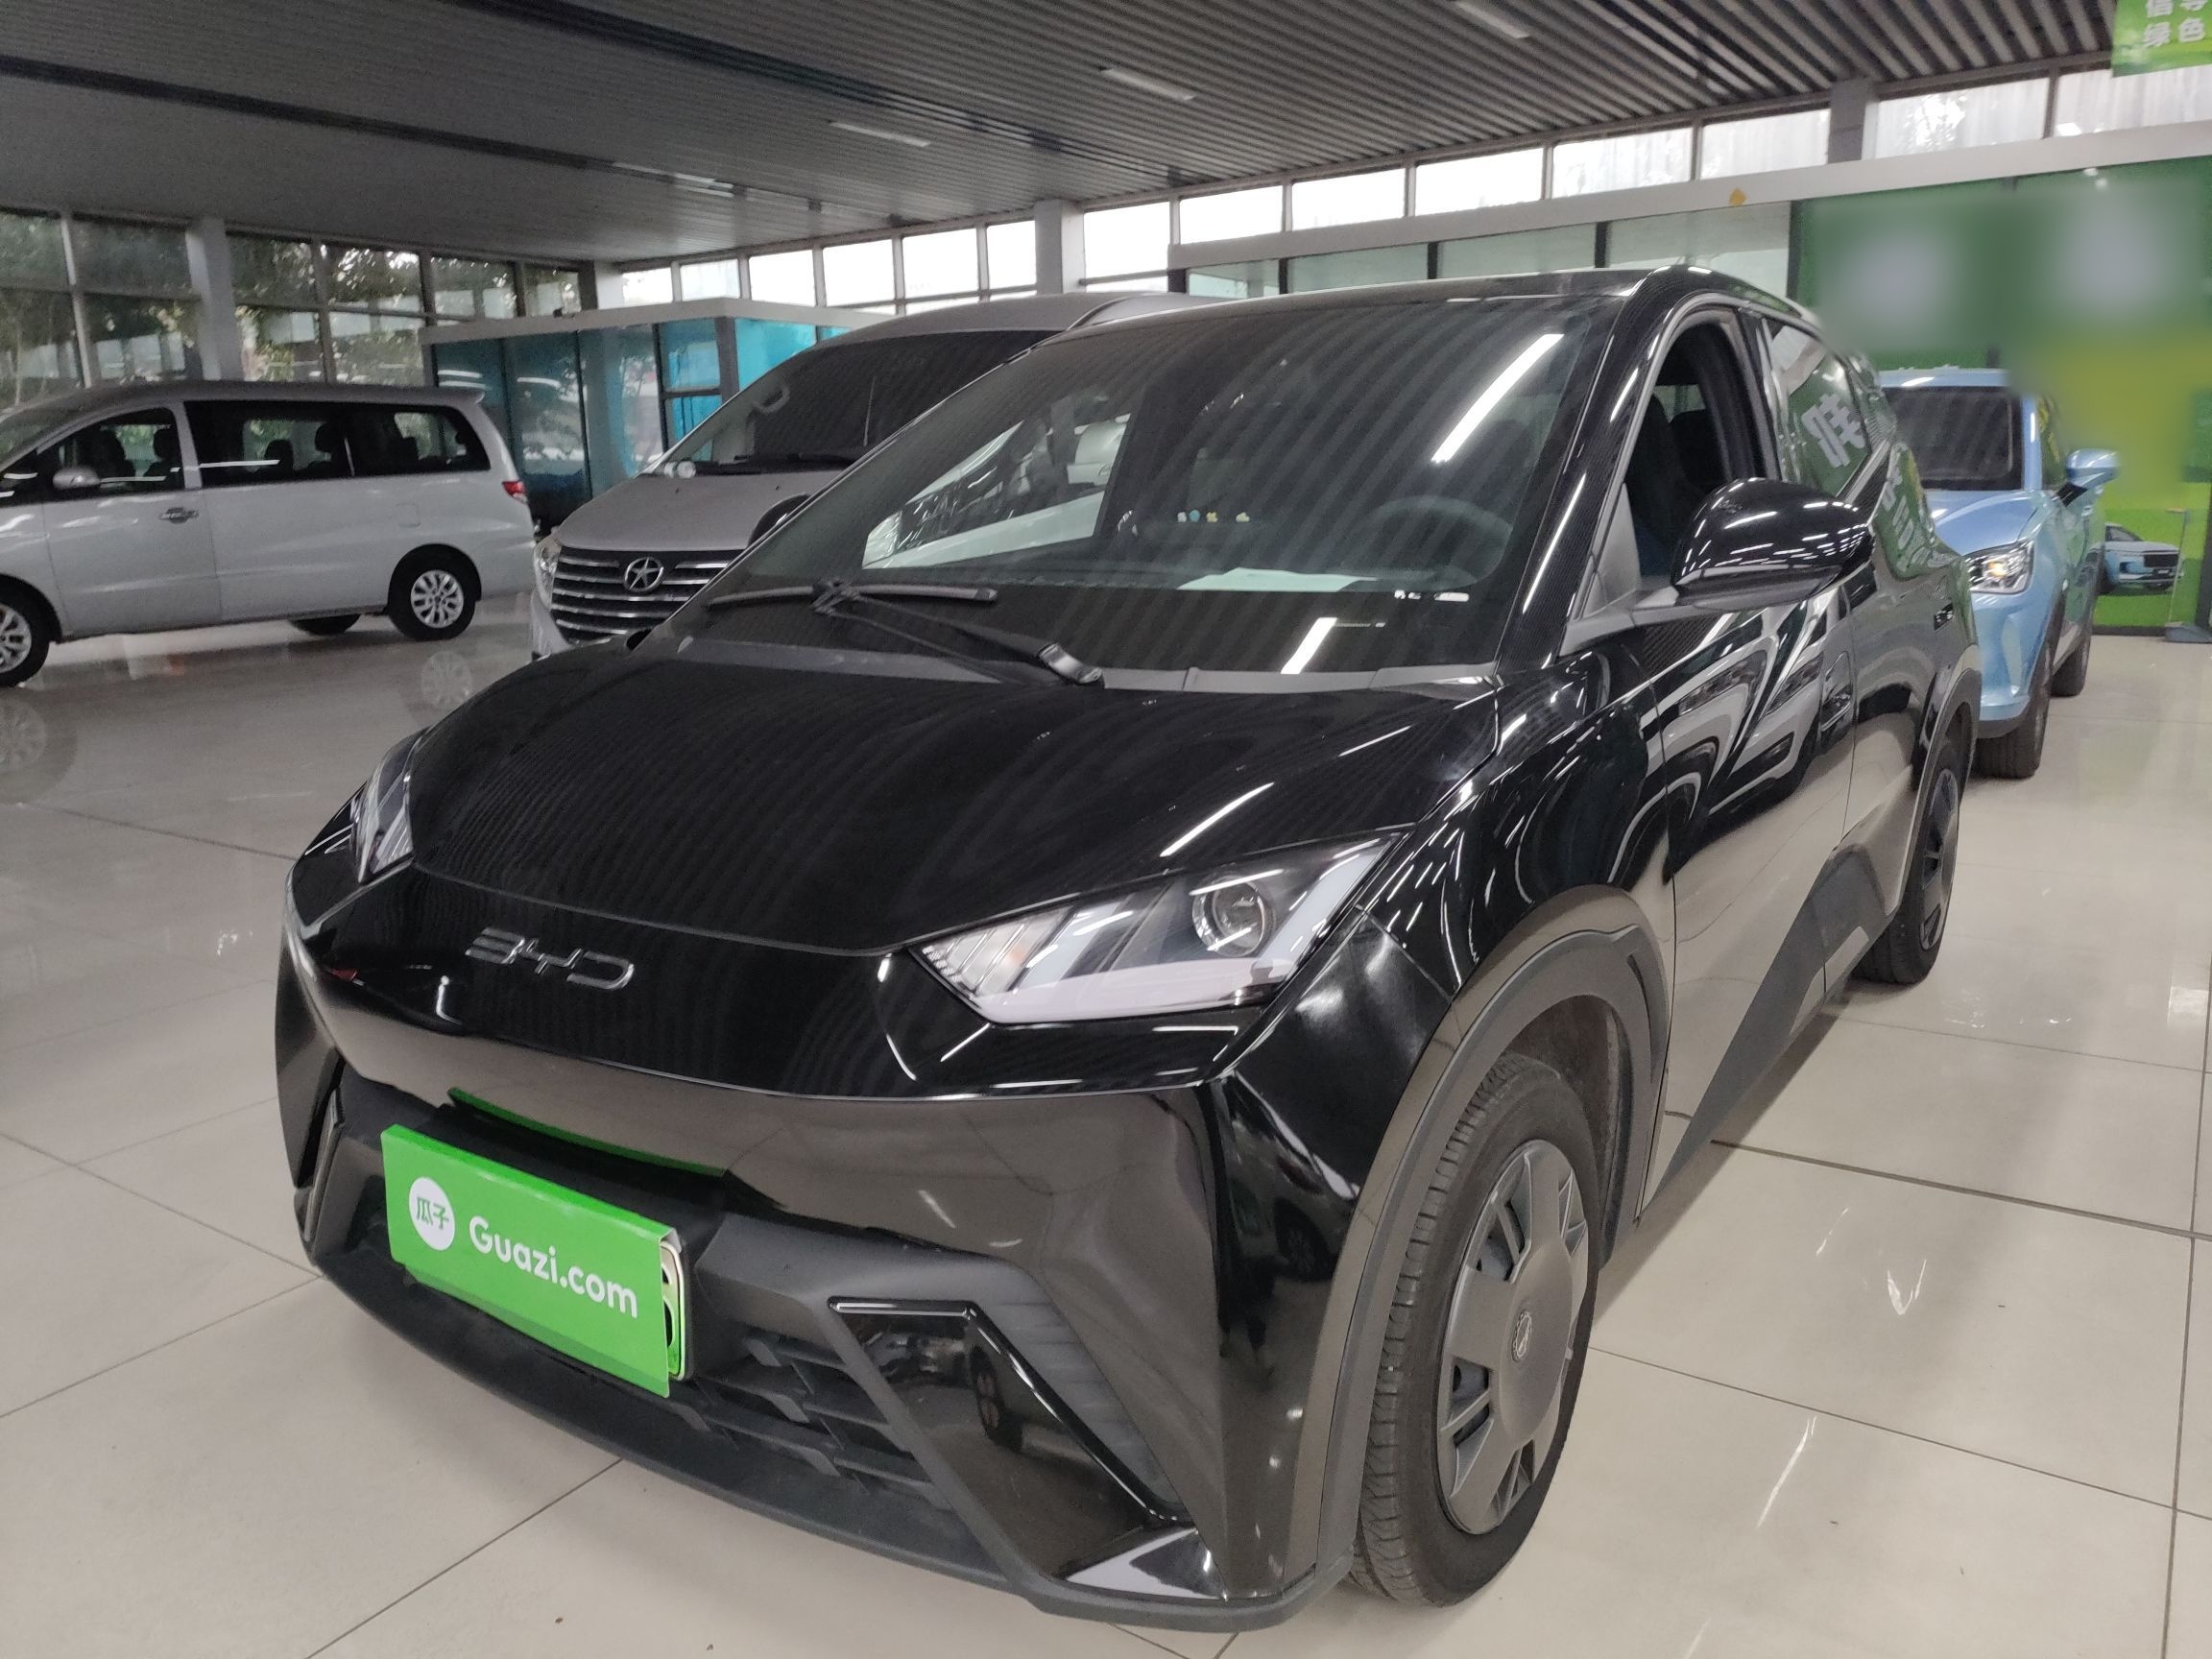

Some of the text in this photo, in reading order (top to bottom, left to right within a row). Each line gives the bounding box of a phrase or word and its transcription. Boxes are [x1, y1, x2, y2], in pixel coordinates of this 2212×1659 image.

[465, 926, 635, 990] BYD
[416, 1196, 449, 1230] 瓜子
[469, 1215, 637, 1319] Guazi.com
